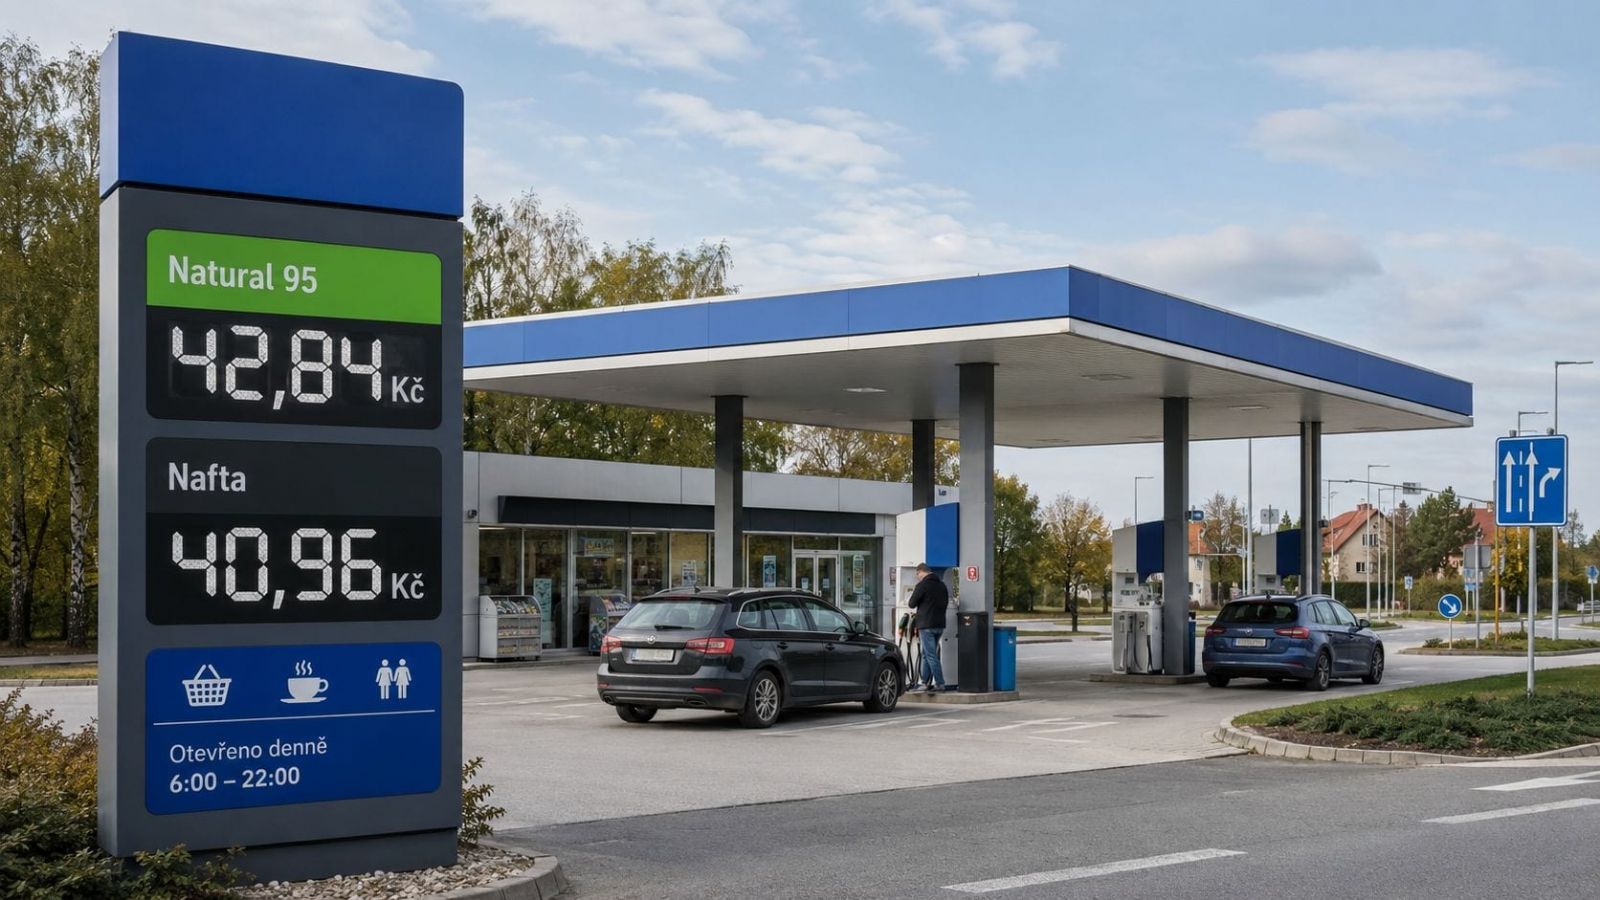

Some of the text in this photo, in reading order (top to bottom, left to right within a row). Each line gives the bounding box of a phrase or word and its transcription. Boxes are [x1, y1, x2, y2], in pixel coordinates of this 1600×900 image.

[168, 255, 318, 294] Natural 95
[172, 324, 425, 410] 42,84 Kč
[168, 462, 246, 492] Nafta
[172, 527, 425, 610] 40,96 Kč
[169, 736, 328, 764] Otevřeno denně
[169, 772, 217, 794] 6:00
[241, 766, 300, 789] 22:00
